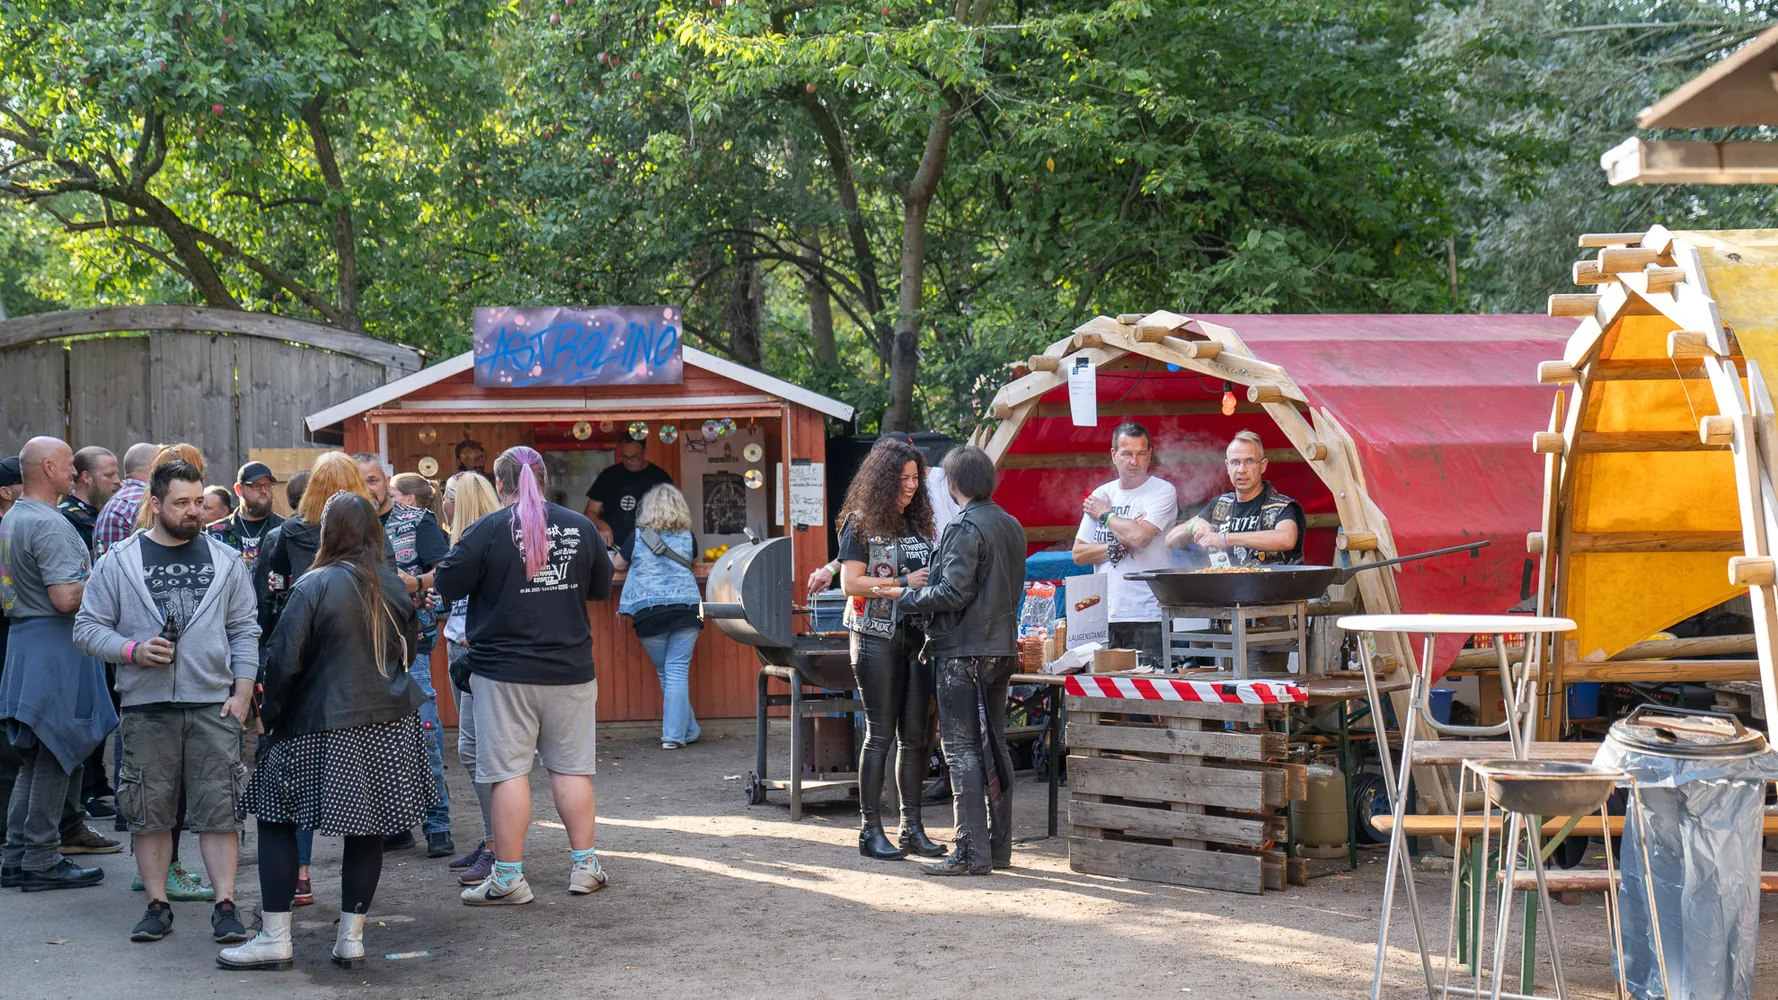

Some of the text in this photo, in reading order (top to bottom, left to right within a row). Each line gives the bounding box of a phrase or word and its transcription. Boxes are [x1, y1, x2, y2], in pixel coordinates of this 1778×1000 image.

[476, 321, 678, 380] ASTROLINO
[151, 576, 210, 589] 2019
[1068, 630, 1107, 642] LAUGENSTANGE
